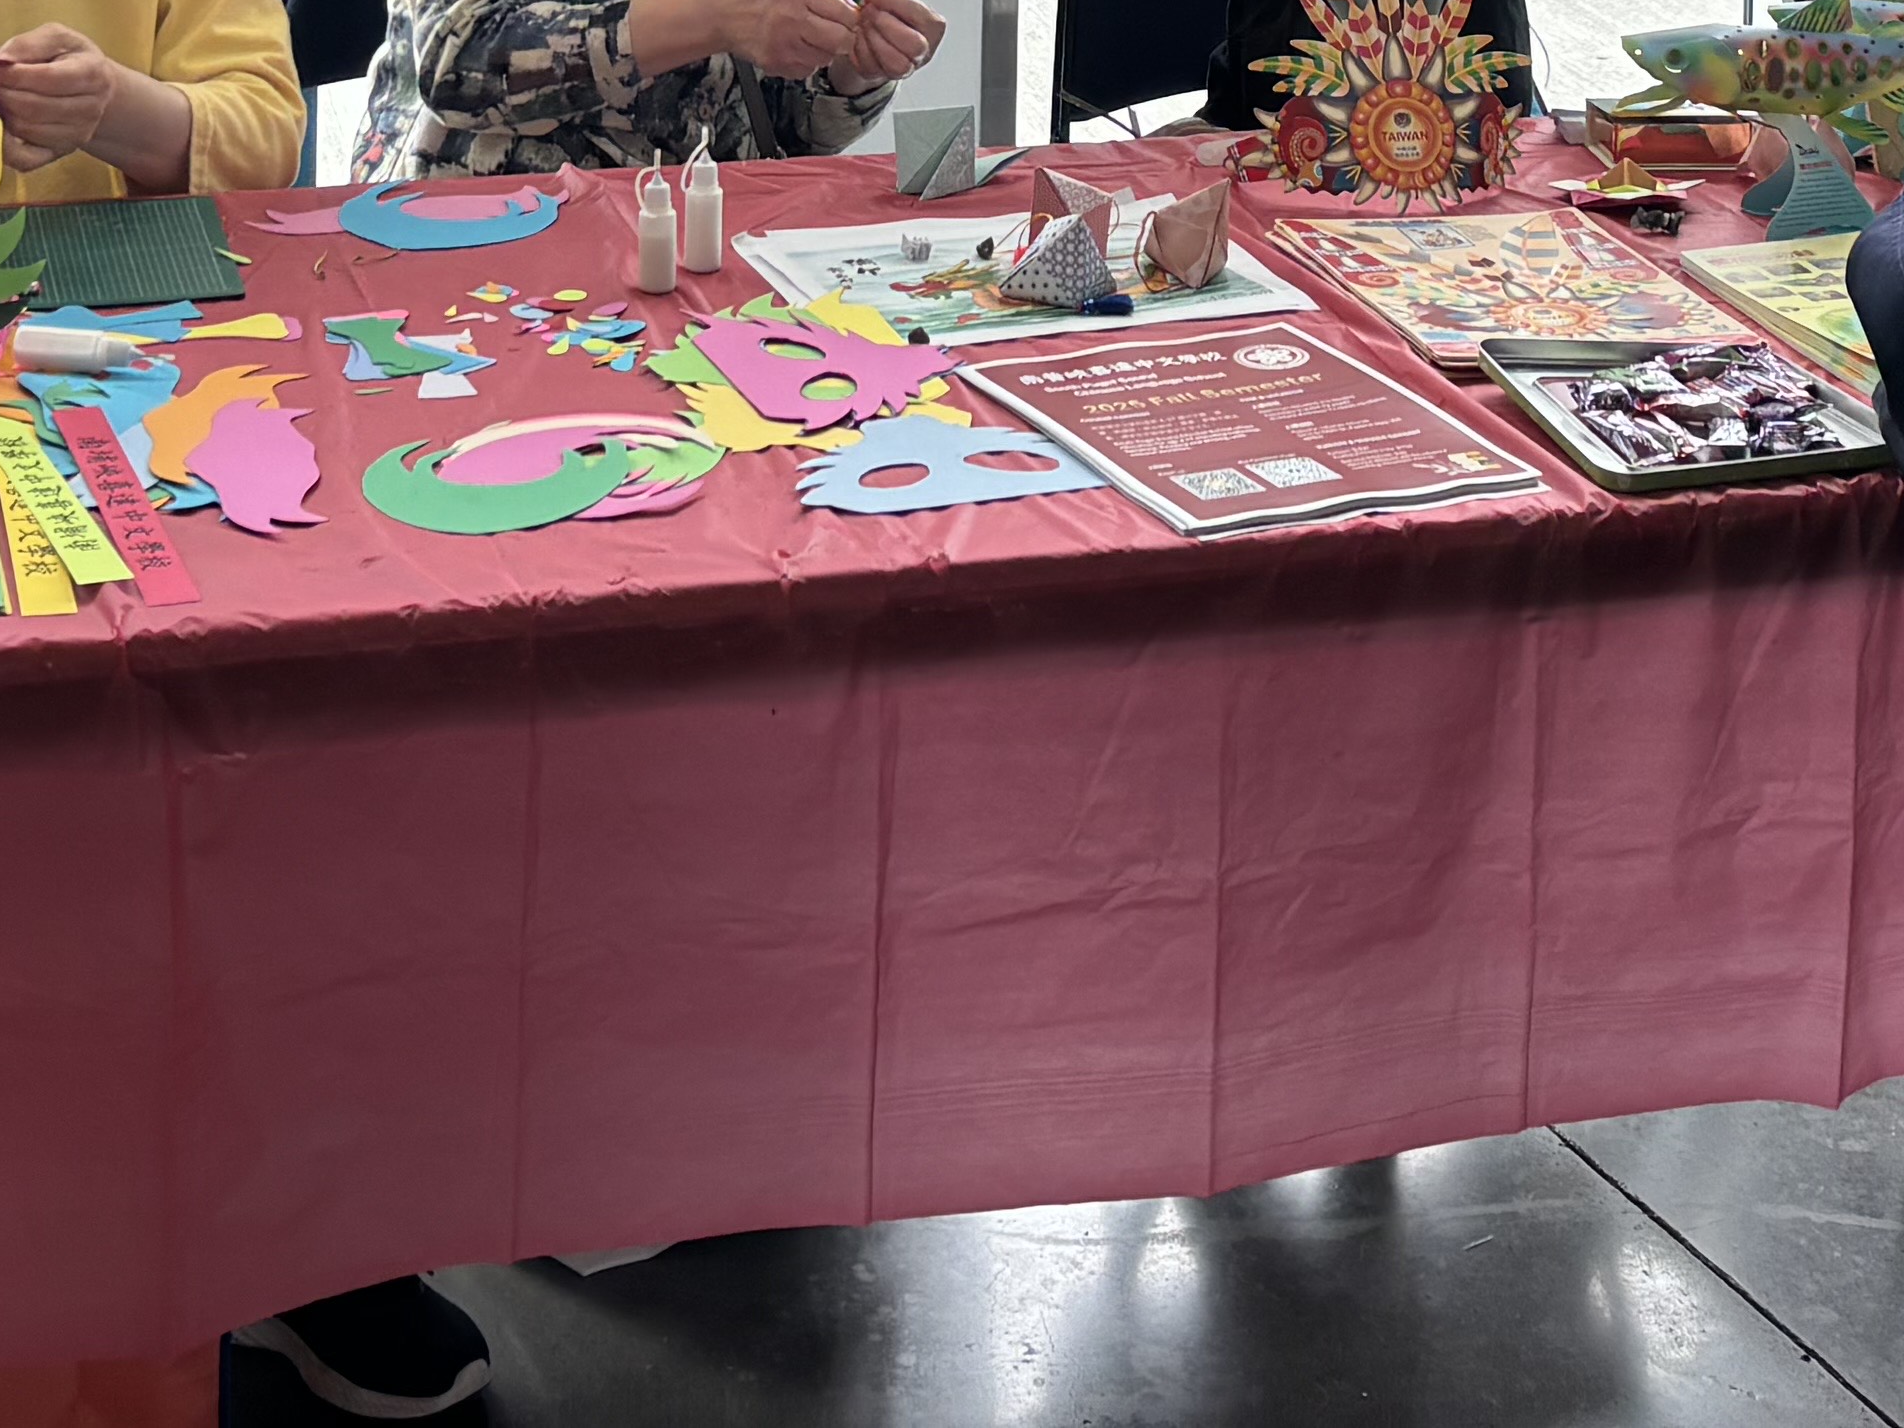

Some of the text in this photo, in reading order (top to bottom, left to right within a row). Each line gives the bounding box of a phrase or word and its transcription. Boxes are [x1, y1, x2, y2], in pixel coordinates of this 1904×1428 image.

[1382, 131, 1428, 142] TAIWAN
[1151, 391, 1201, 408] Fall
[1207, 372, 1323, 401] Semester
